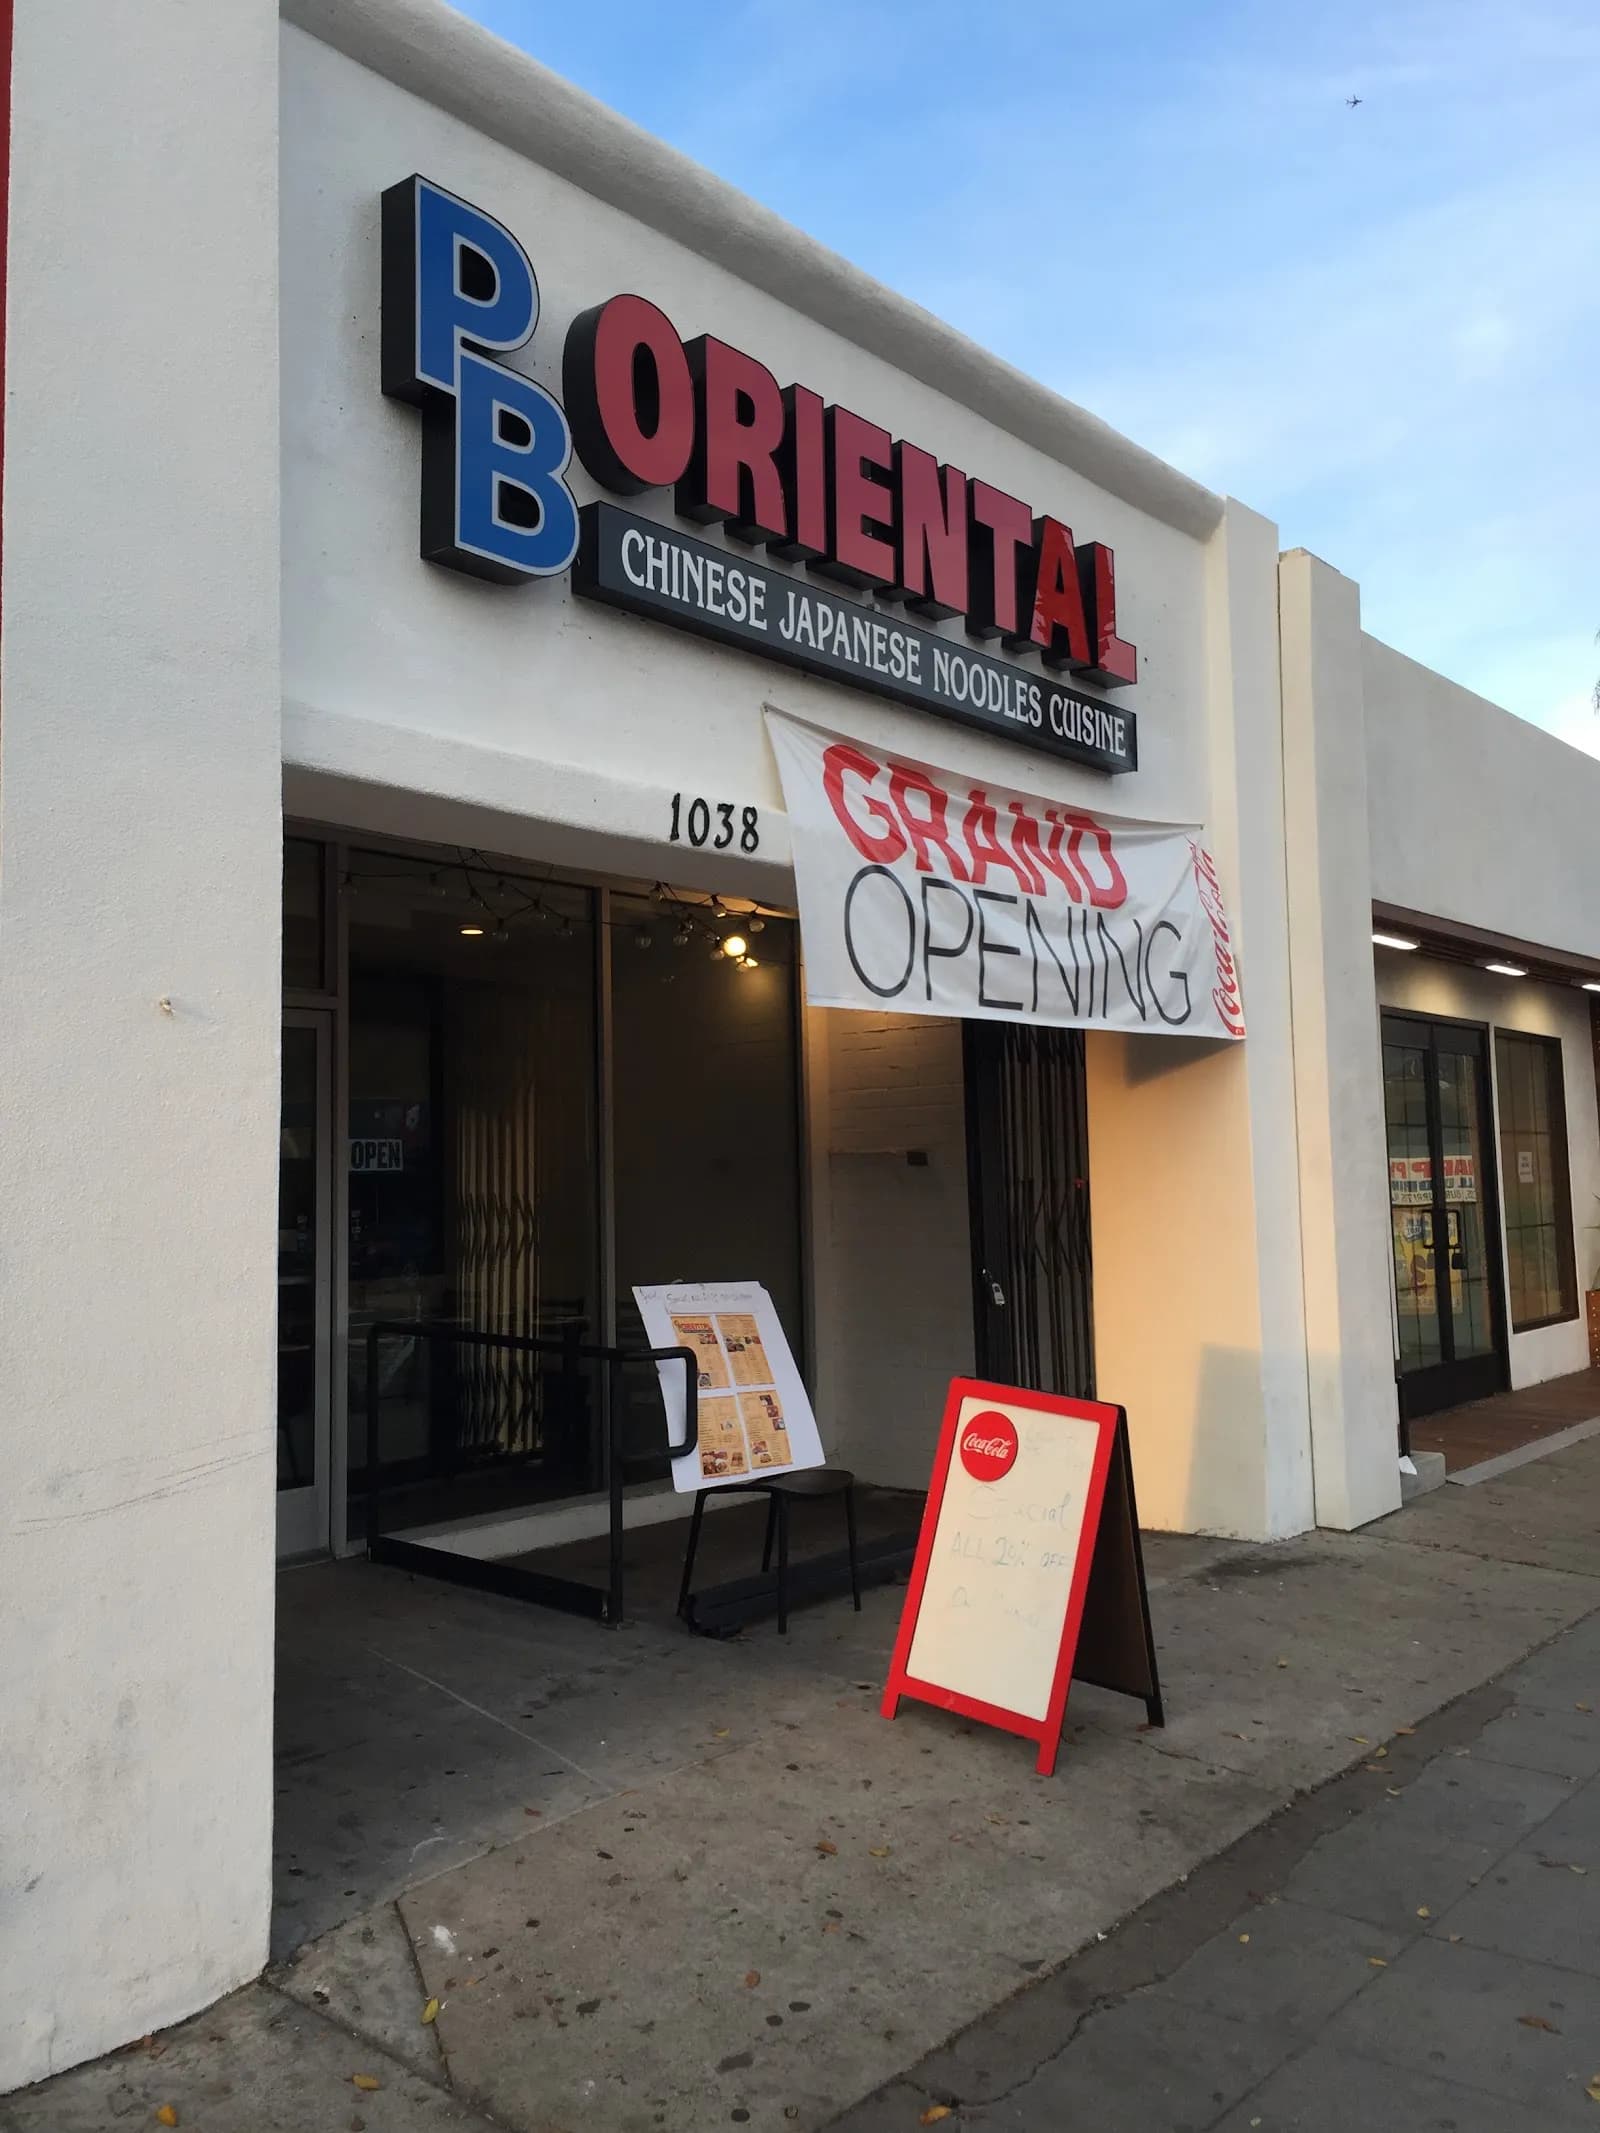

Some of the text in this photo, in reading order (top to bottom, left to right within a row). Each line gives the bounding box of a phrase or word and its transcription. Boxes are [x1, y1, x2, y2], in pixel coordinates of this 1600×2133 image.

[592, 292, 1138, 686] ORIENTAL
[621, 528, 1127, 758] CHINESE JAPANESE NOODLES CUISINE
[669, 791, 761, 854] 1038
[822, 743, 1129, 911] GRAND
[843, 864, 1193, 1026] OPENING
[351, 1140, 401, 1169] OPEN
